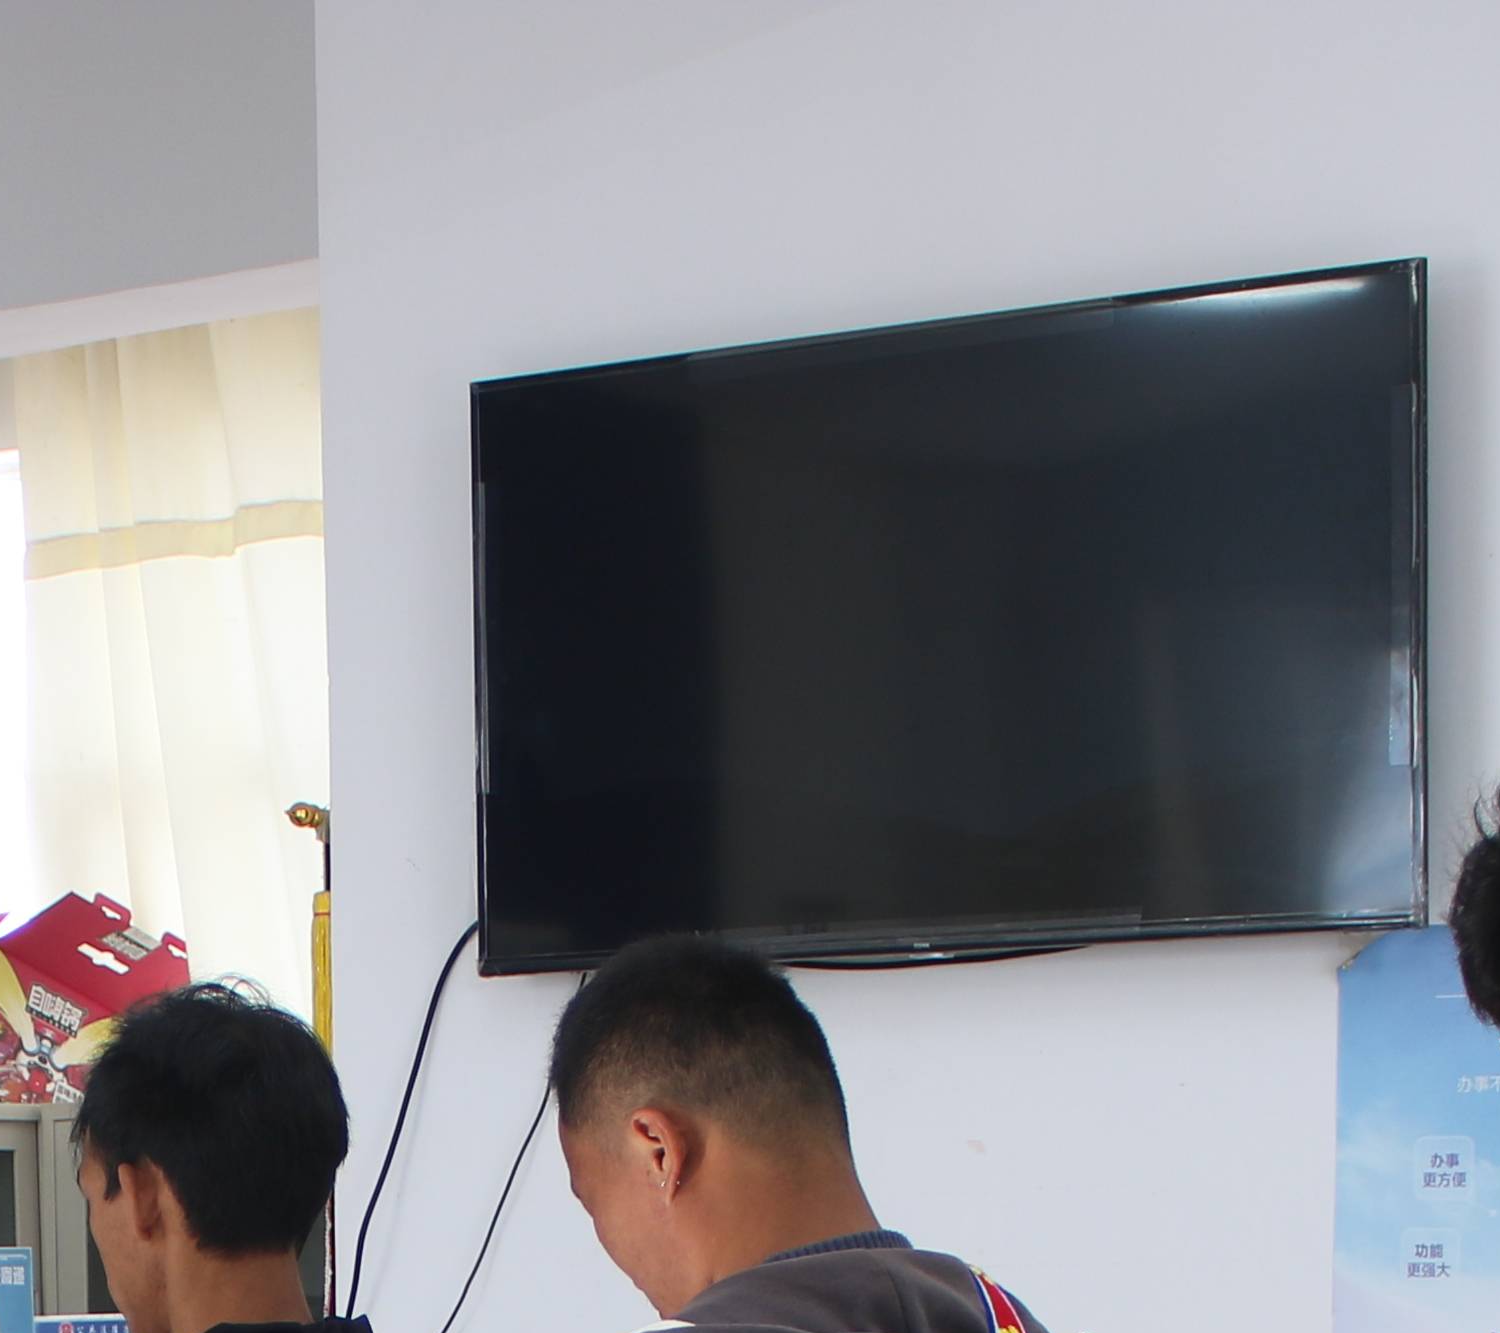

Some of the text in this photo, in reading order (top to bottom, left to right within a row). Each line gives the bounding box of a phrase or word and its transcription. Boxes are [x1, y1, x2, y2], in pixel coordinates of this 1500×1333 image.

[1430, 1153, 1460, 1168] 办事
[1423, 1172, 1467, 1188] 更方便
[1415, 1244, 1443, 1259] 功能
[1408, 1262, 1451, 1278] 更强大
